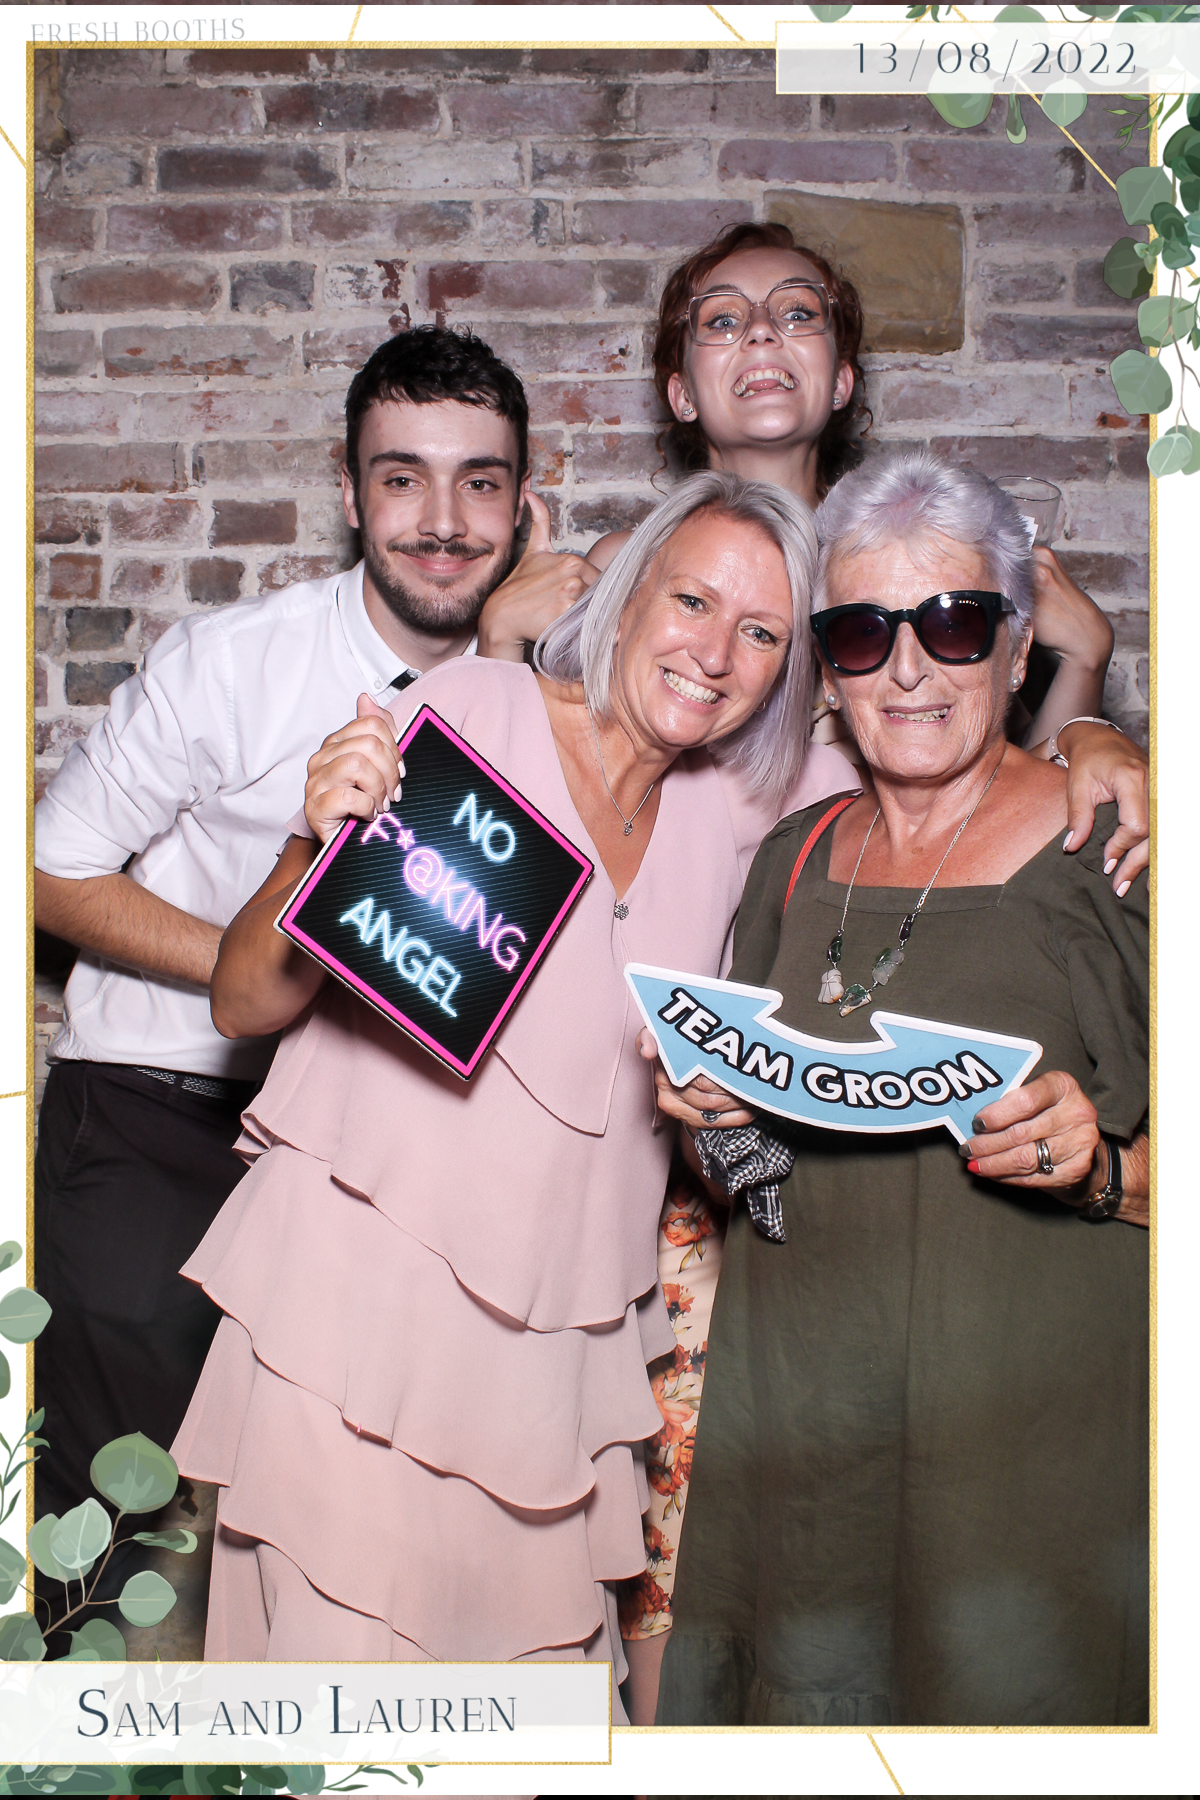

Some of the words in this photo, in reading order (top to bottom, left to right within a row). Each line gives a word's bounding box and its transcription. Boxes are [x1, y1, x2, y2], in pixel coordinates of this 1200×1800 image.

[453, 793, 516, 863] NO
[339, 897, 462, 1018] ANGEL
[658, 987, 794, 1091] TEAM
[801, 1050, 1003, 1110] GROOM
